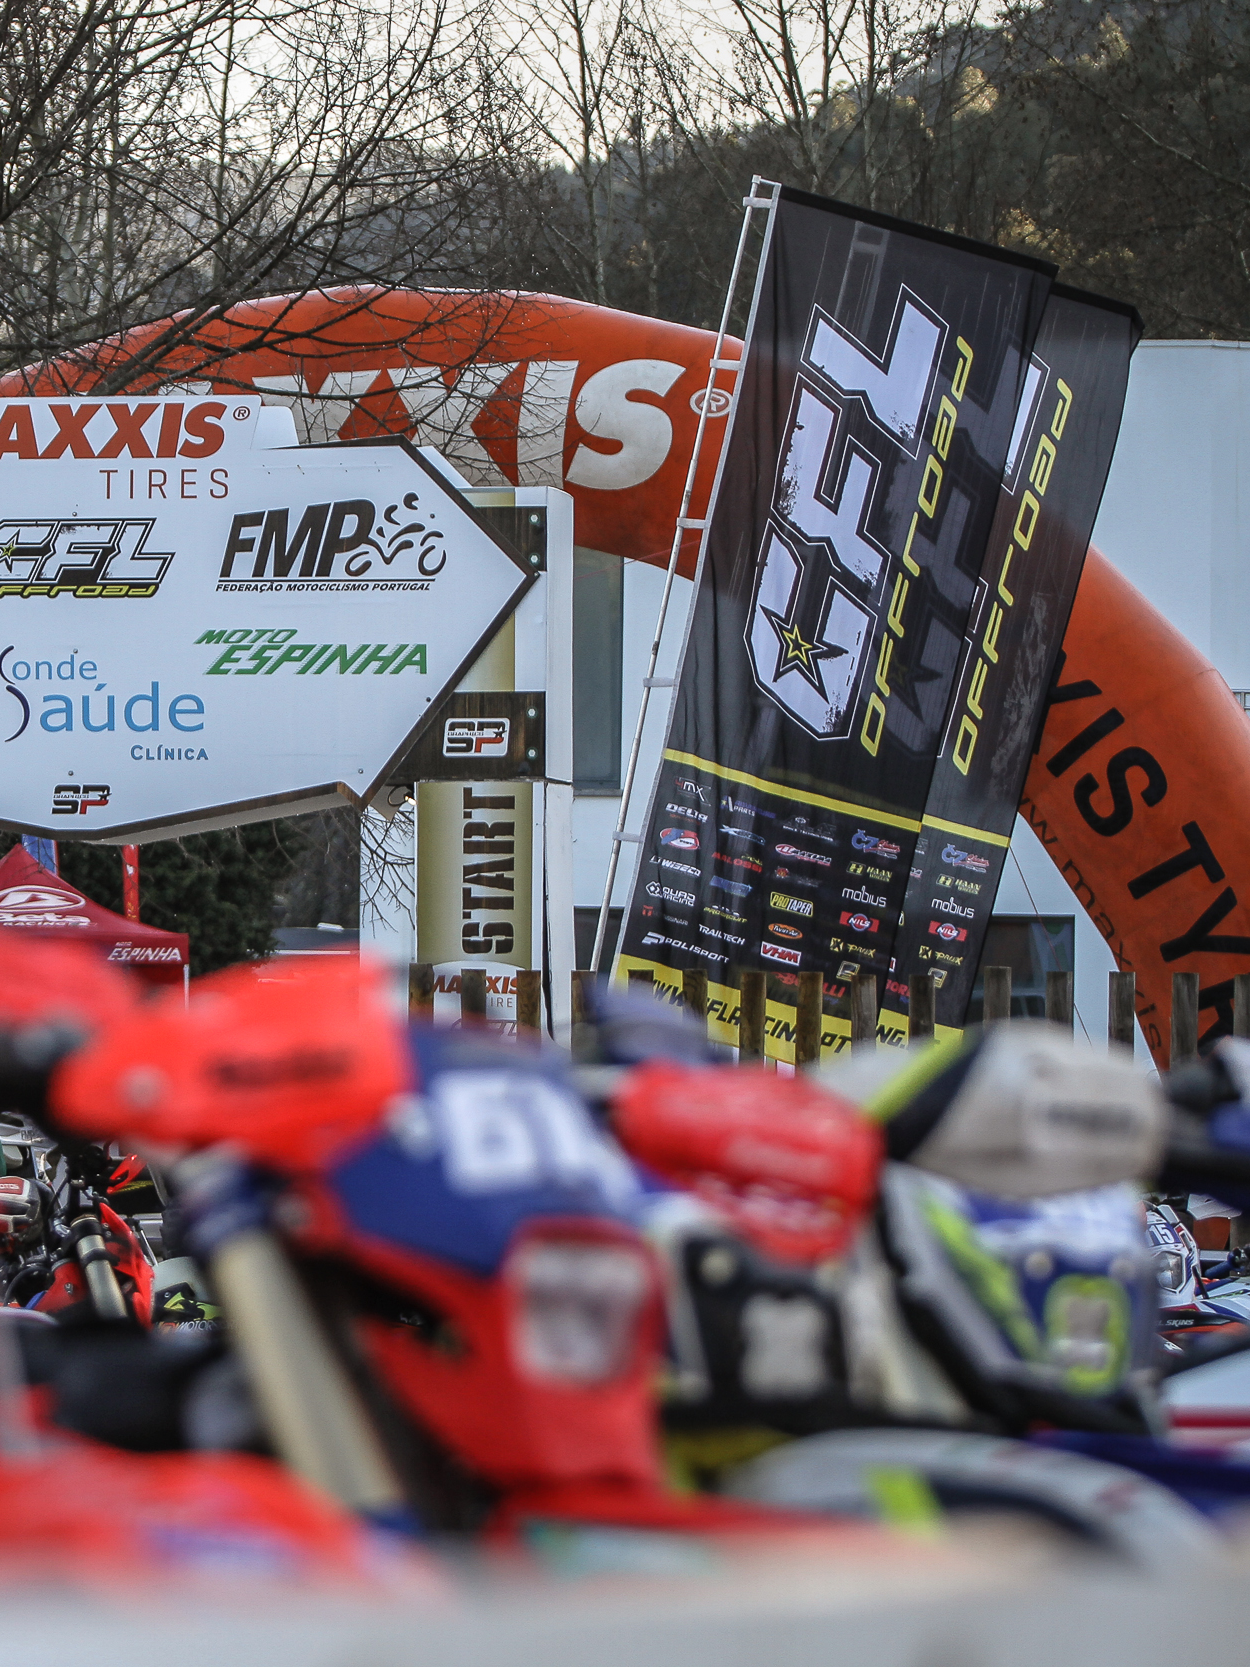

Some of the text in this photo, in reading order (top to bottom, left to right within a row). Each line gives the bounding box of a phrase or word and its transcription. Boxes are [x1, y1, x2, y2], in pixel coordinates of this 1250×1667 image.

[100, 469, 229, 499] TIRES
[219, 499, 377, 578] FMP
[215, 581, 432, 593] FEDERAÇÃO MOTOCICLISMO PORTUGAL
[194, 628, 299, 645] MOTO
[203, 643, 428, 675] ESPINHA
[461, 787, 517, 955] START
[106, 947, 182, 962] ESPINHA
